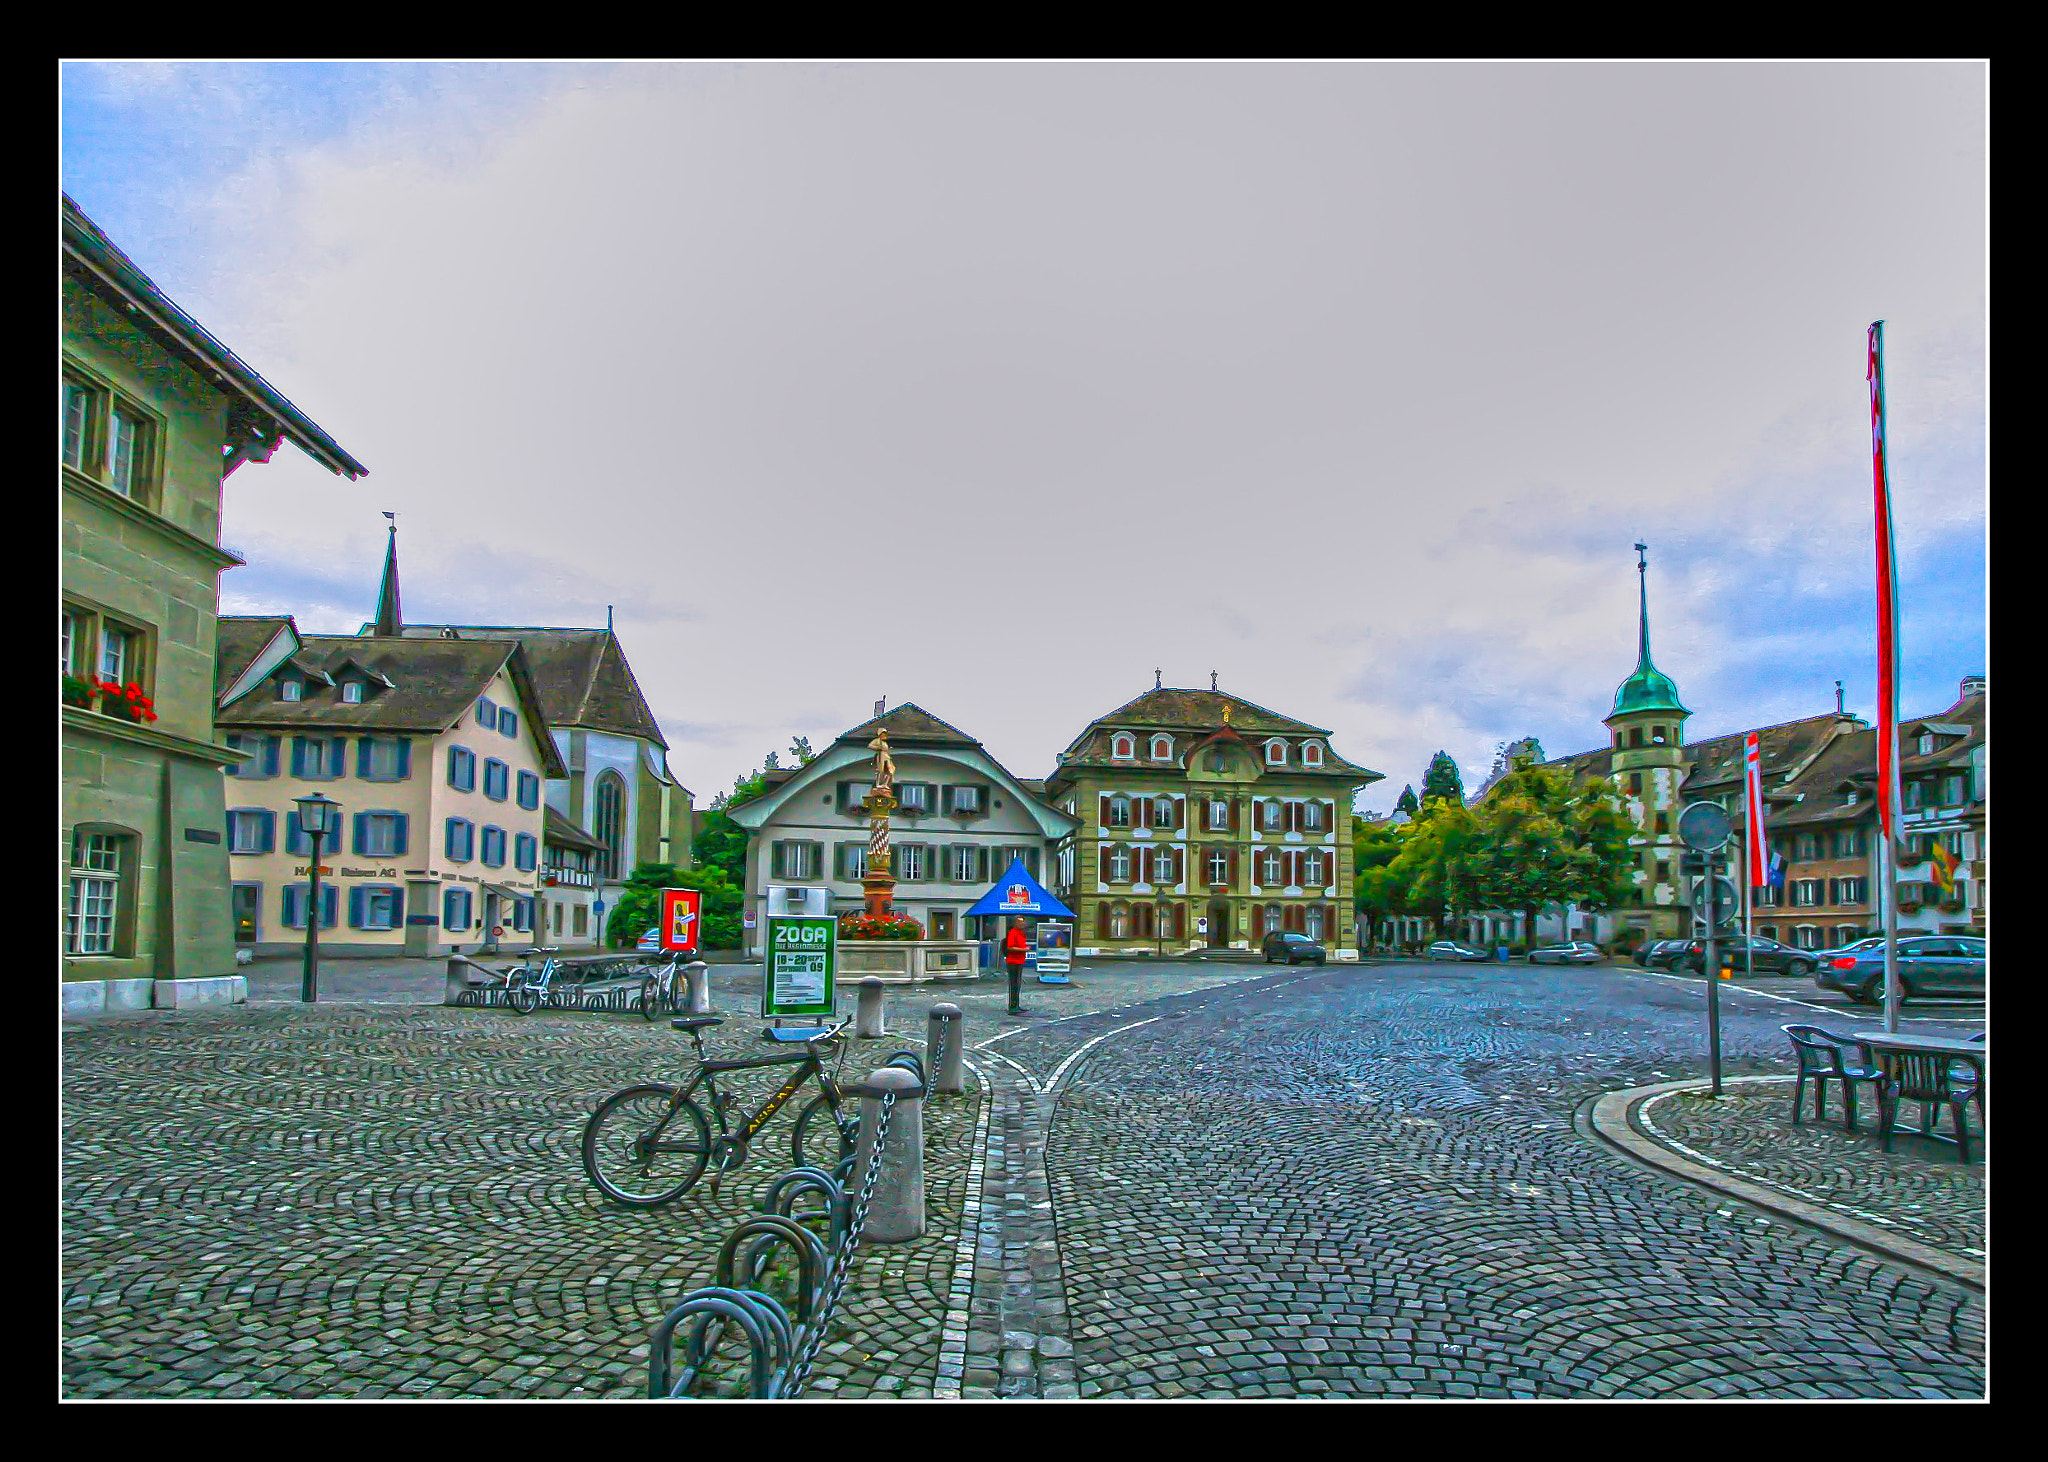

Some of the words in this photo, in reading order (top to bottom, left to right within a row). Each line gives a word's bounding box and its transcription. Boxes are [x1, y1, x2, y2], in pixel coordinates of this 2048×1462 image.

[379, 868, 397, 878] AG
[775, 926, 827, 943] ZOGA
[810, 962, 823, 972] 09
